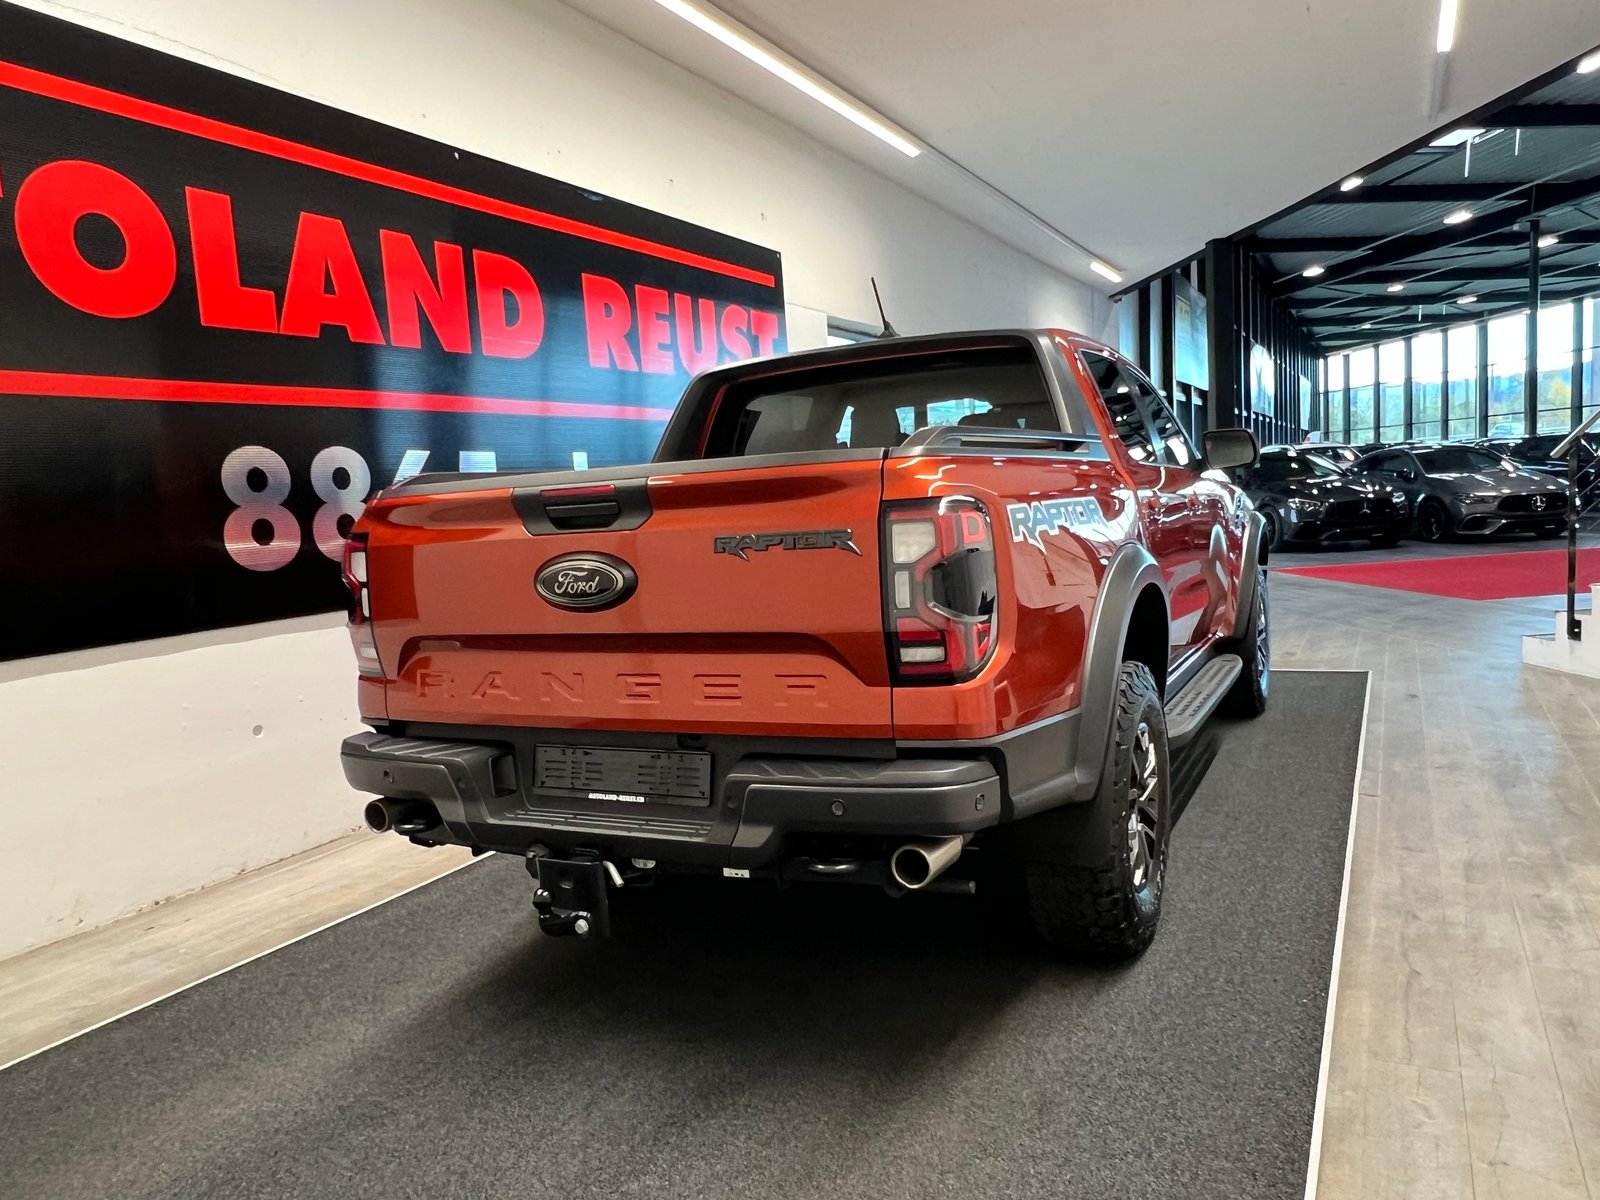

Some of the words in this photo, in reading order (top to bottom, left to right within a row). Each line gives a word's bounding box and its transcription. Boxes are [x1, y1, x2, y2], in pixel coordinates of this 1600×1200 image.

[0, 159, 544, 359] OLAND
[581, 272, 779, 377] REUST
[1006, 496, 1108, 555] RAPTOR
[713, 528, 863, 561] RAPTOR
[554, 570, 600, 594] Ford
[416, 671, 830, 708] RANGER
